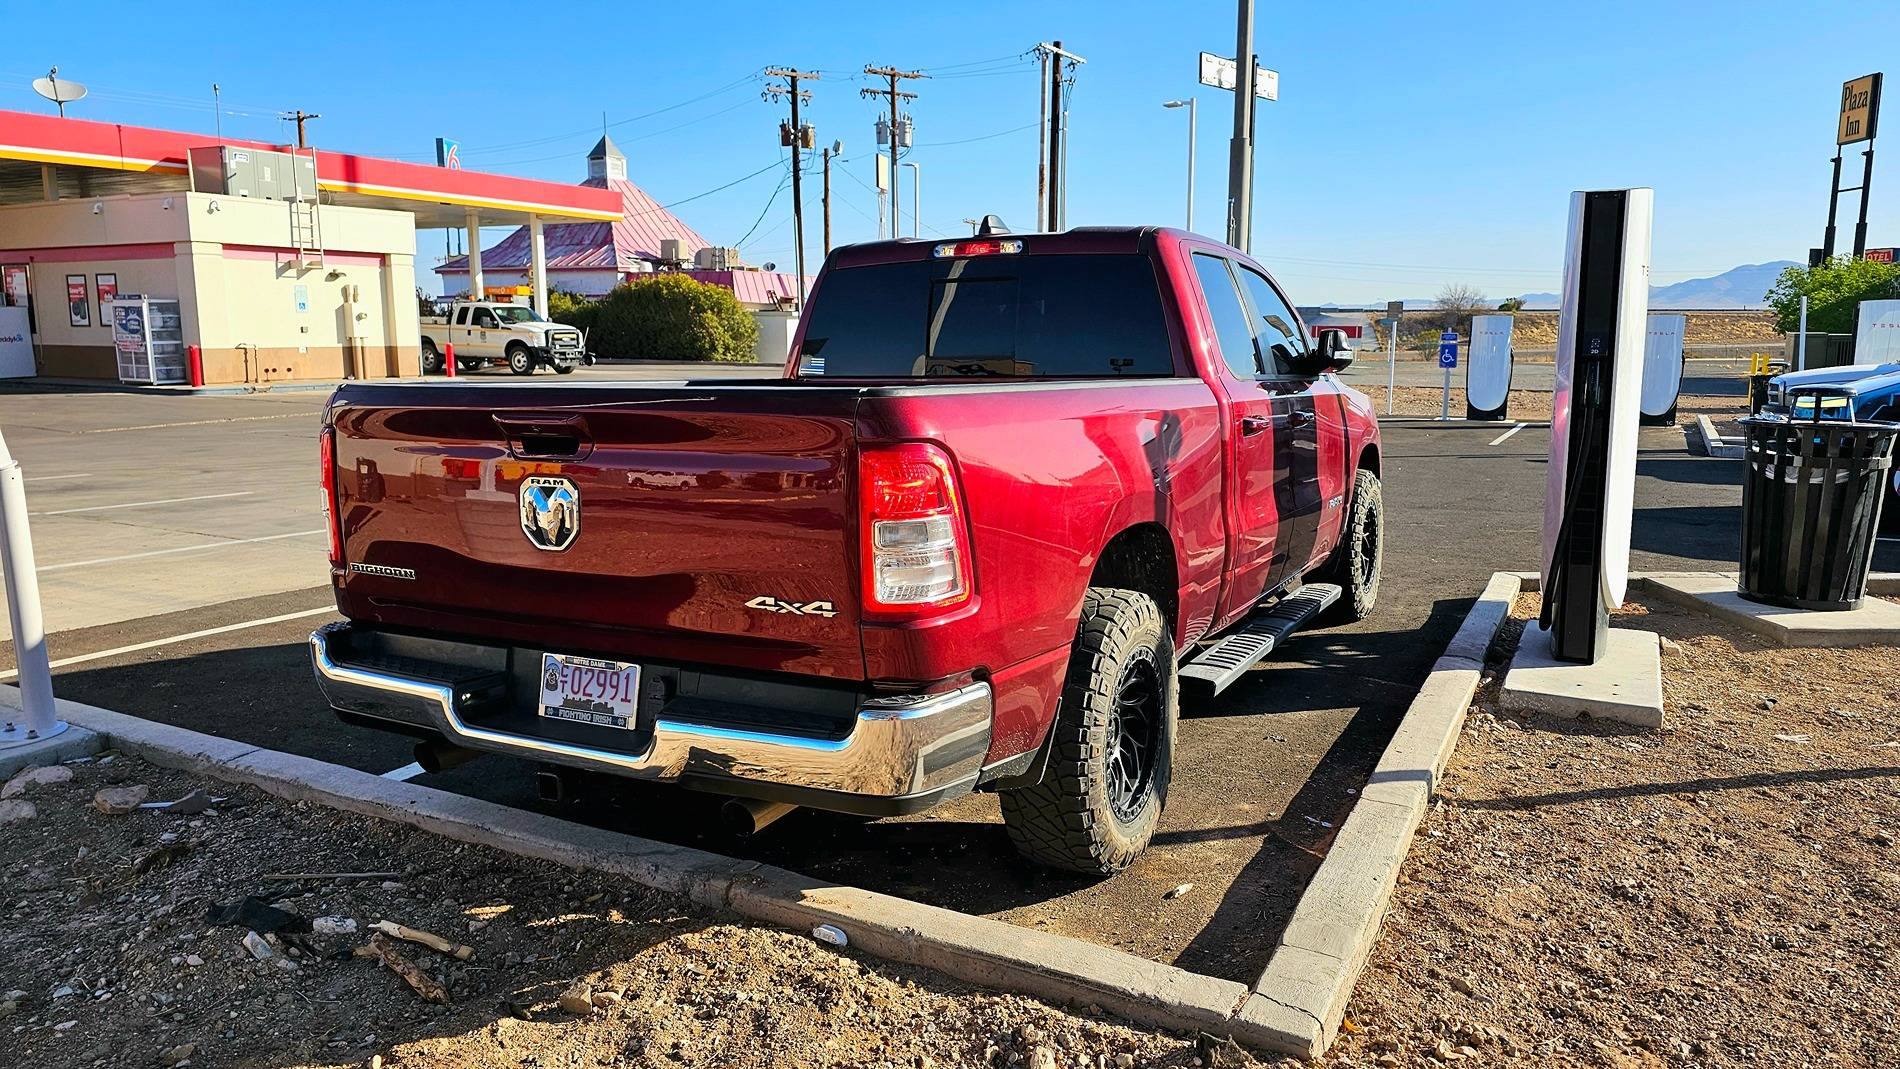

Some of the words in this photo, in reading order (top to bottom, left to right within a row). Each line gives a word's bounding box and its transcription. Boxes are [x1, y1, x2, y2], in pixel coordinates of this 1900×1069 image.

[1842, 85, 1868, 113] Plaza
[1845, 116, 1860, 137] Inn
[447, 144, 461, 170] 6
[1866, 252, 1890, 262] OTEL
[530, 478, 564, 486] RAM
[350, 562, 416, 580] BIGHORN
[744, 596, 840, 618] 4x4
[573, 657, 590, 666] NOTRE
[590, 660, 606, 668] DAME
[570, 666, 632, 703] 02991
[558, 709, 592, 721] FIGHTING
[592, 713, 612, 725] IRISH
